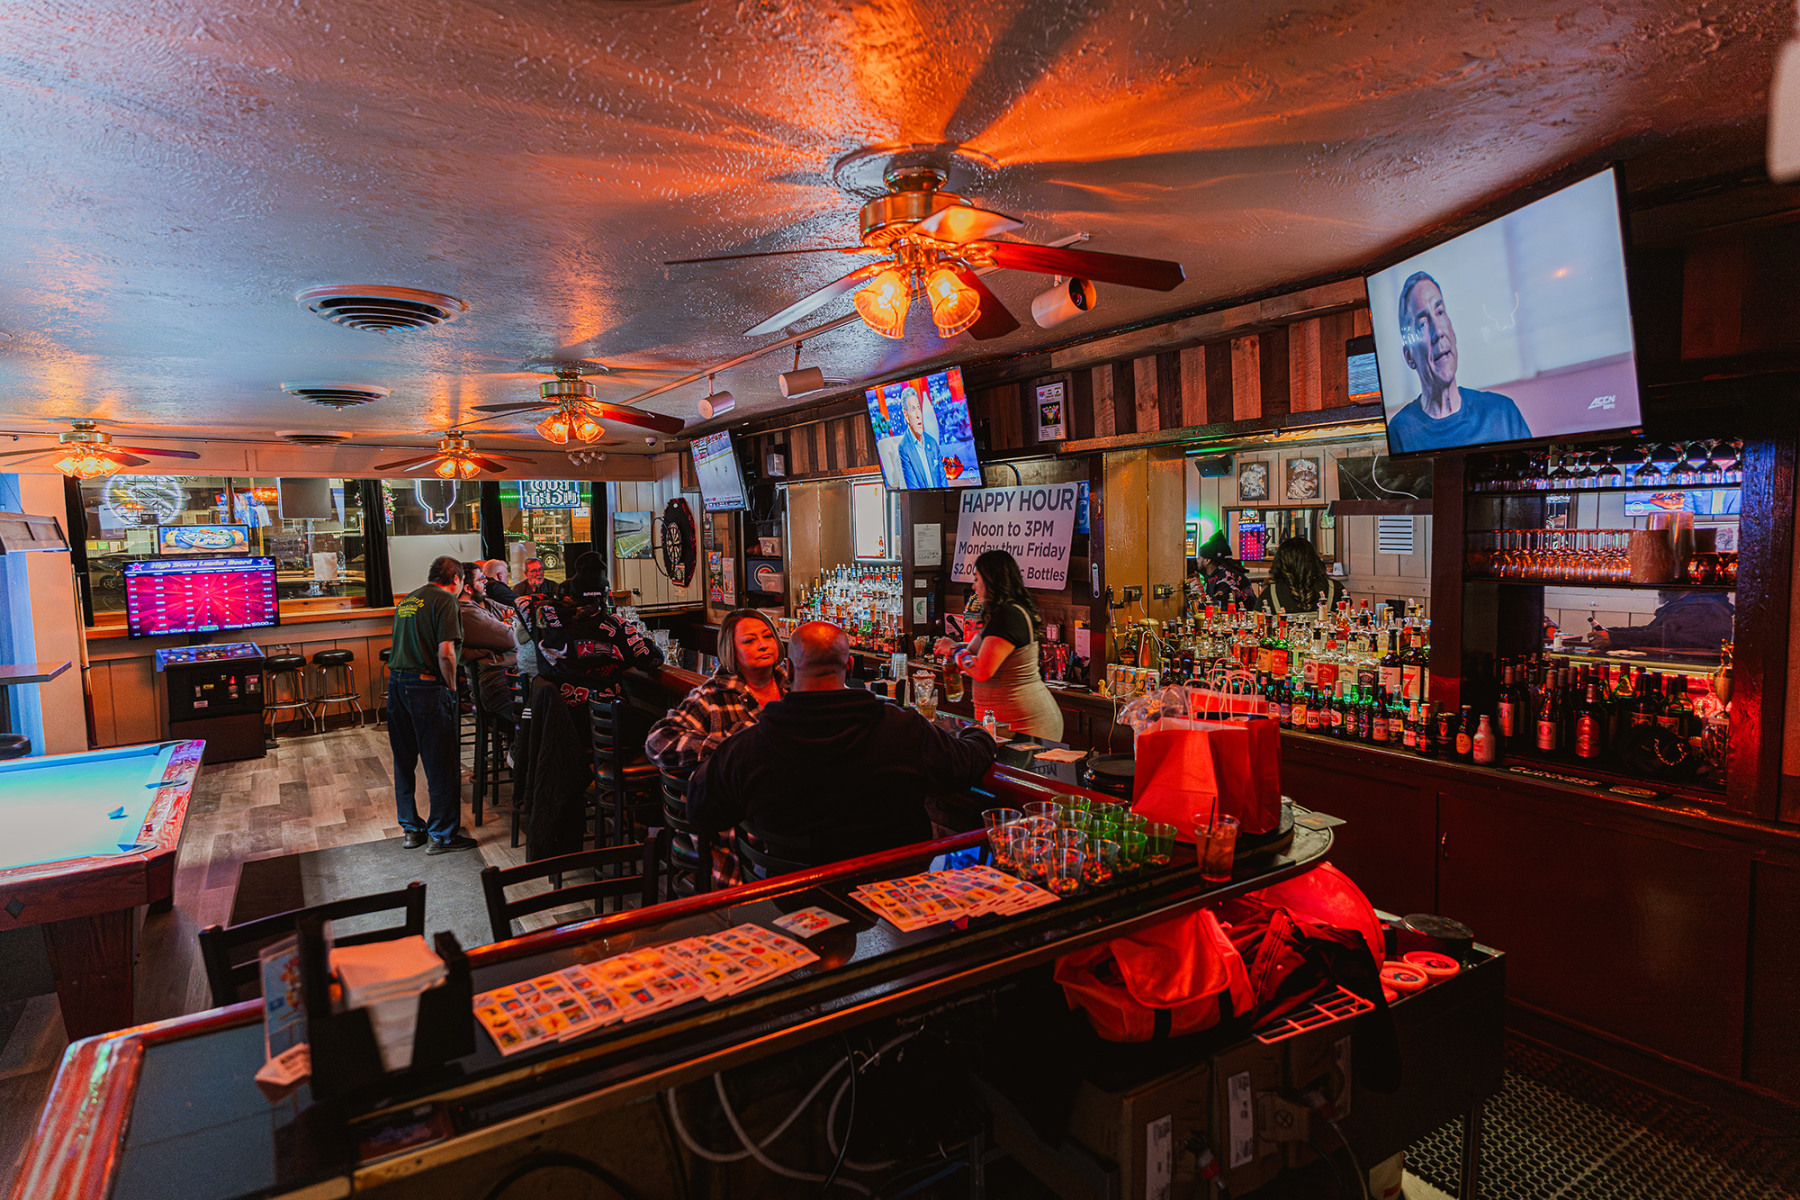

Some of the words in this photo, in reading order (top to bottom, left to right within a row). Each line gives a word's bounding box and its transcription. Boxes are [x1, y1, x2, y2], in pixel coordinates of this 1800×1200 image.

[962, 491, 1016, 513] HAPPY
[1019, 488, 1074, 512] HOUR
[972, 521, 1004, 537] Noon
[1008, 521, 1021, 537] to
[1024, 520, 1054, 537] 3PM
[1002, 541, 1024, 556] thru
[1027, 542, 1066, 560] Friday
[1027, 567, 1065, 581] Bottles
[1403, 673, 1416, 697] 7
